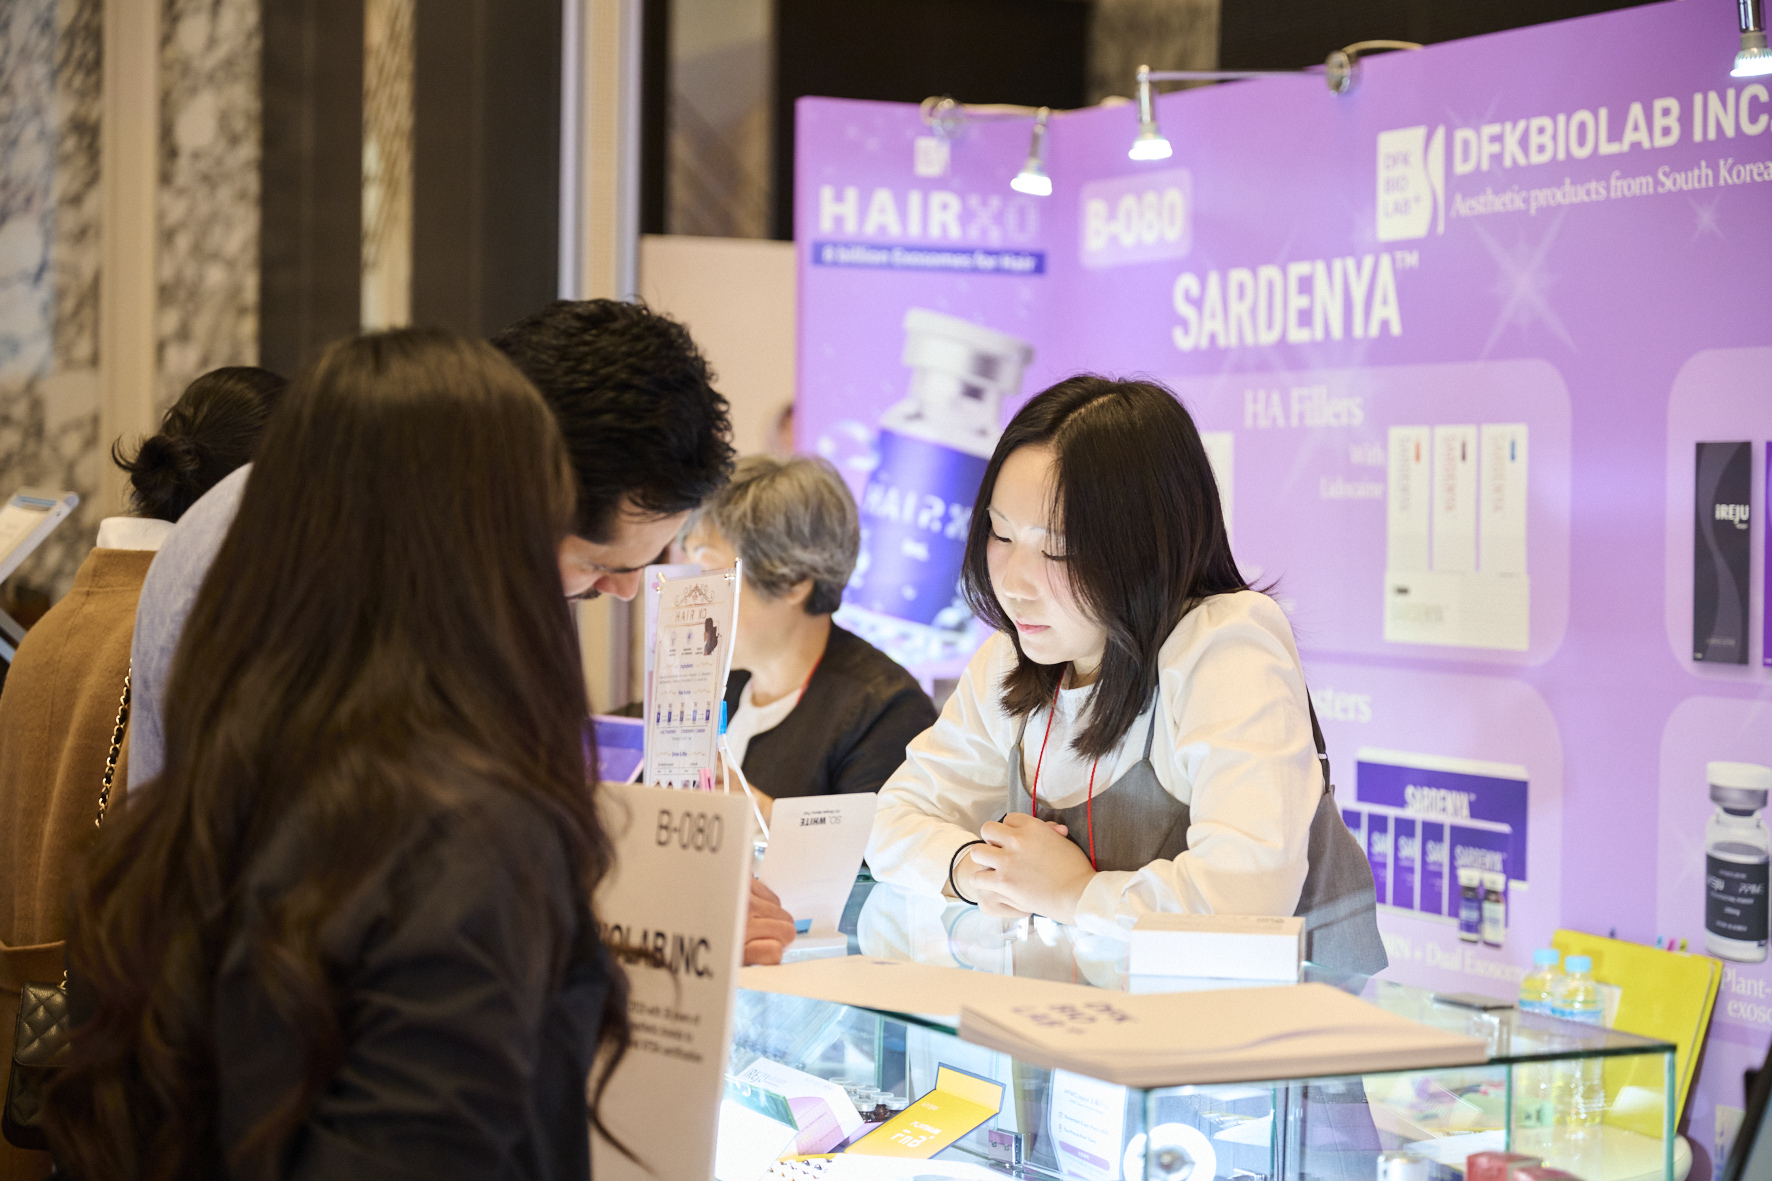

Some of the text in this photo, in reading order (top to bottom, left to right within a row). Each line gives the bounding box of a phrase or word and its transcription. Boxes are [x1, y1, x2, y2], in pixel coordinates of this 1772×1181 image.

[1452, 96, 1681, 176] DFKBIOLAB
[1086, 186, 1185, 252] B-080
[1450, 158, 1772, 218] Aesthetic products from South Korea
[1172, 252, 1403, 352] SARDENYA
[1244, 385, 1365, 429] HA Fillers
[655, 808, 725, 855] B-080
